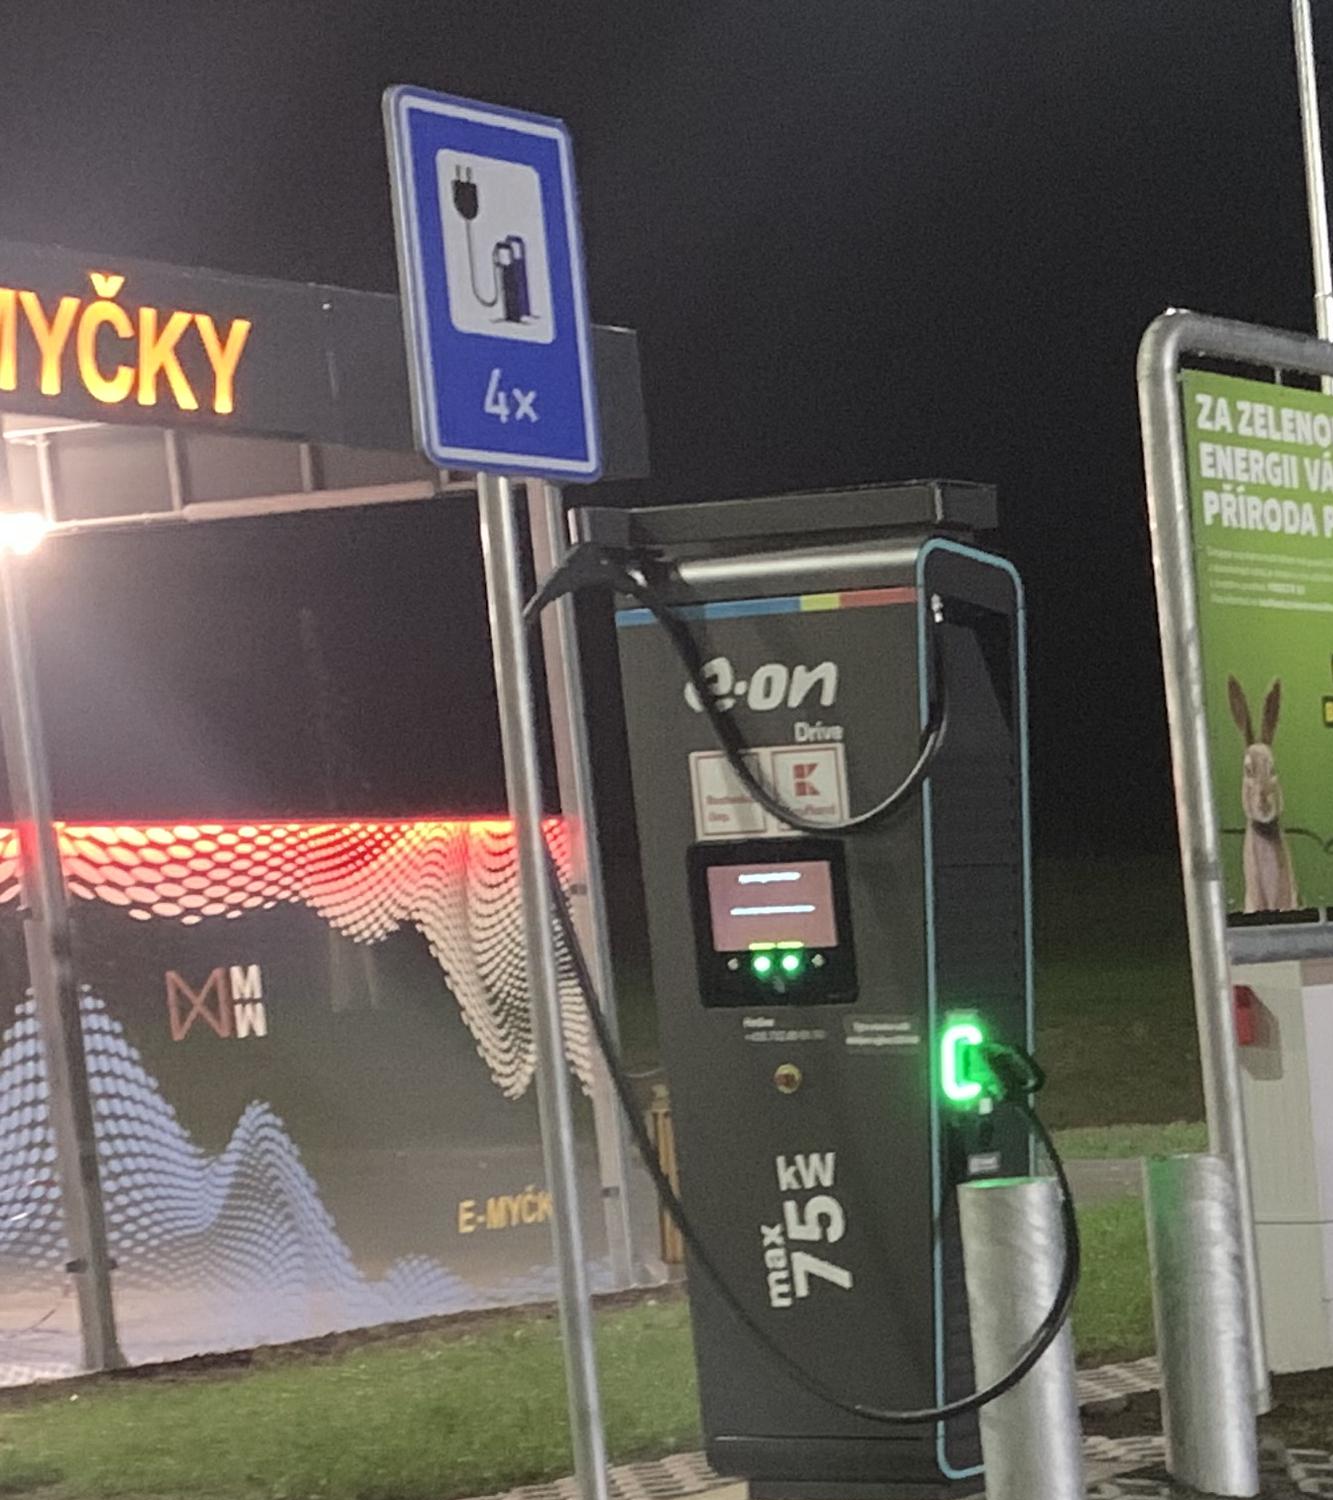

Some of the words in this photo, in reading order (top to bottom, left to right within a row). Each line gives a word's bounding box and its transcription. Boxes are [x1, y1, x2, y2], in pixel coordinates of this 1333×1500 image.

[484, 367, 539, 424] 4x
[1196, 393, 1233, 434] ZA
[1199, 441, 1300, 490] ENERGII
[1202, 483, 1319, 538] PŘÍRODA
[793, 720, 844, 742] Drive
[776, 1151, 837, 1191] kW
[760, 1224, 793, 1308] max
[783, 1195, 854, 1298] 75
